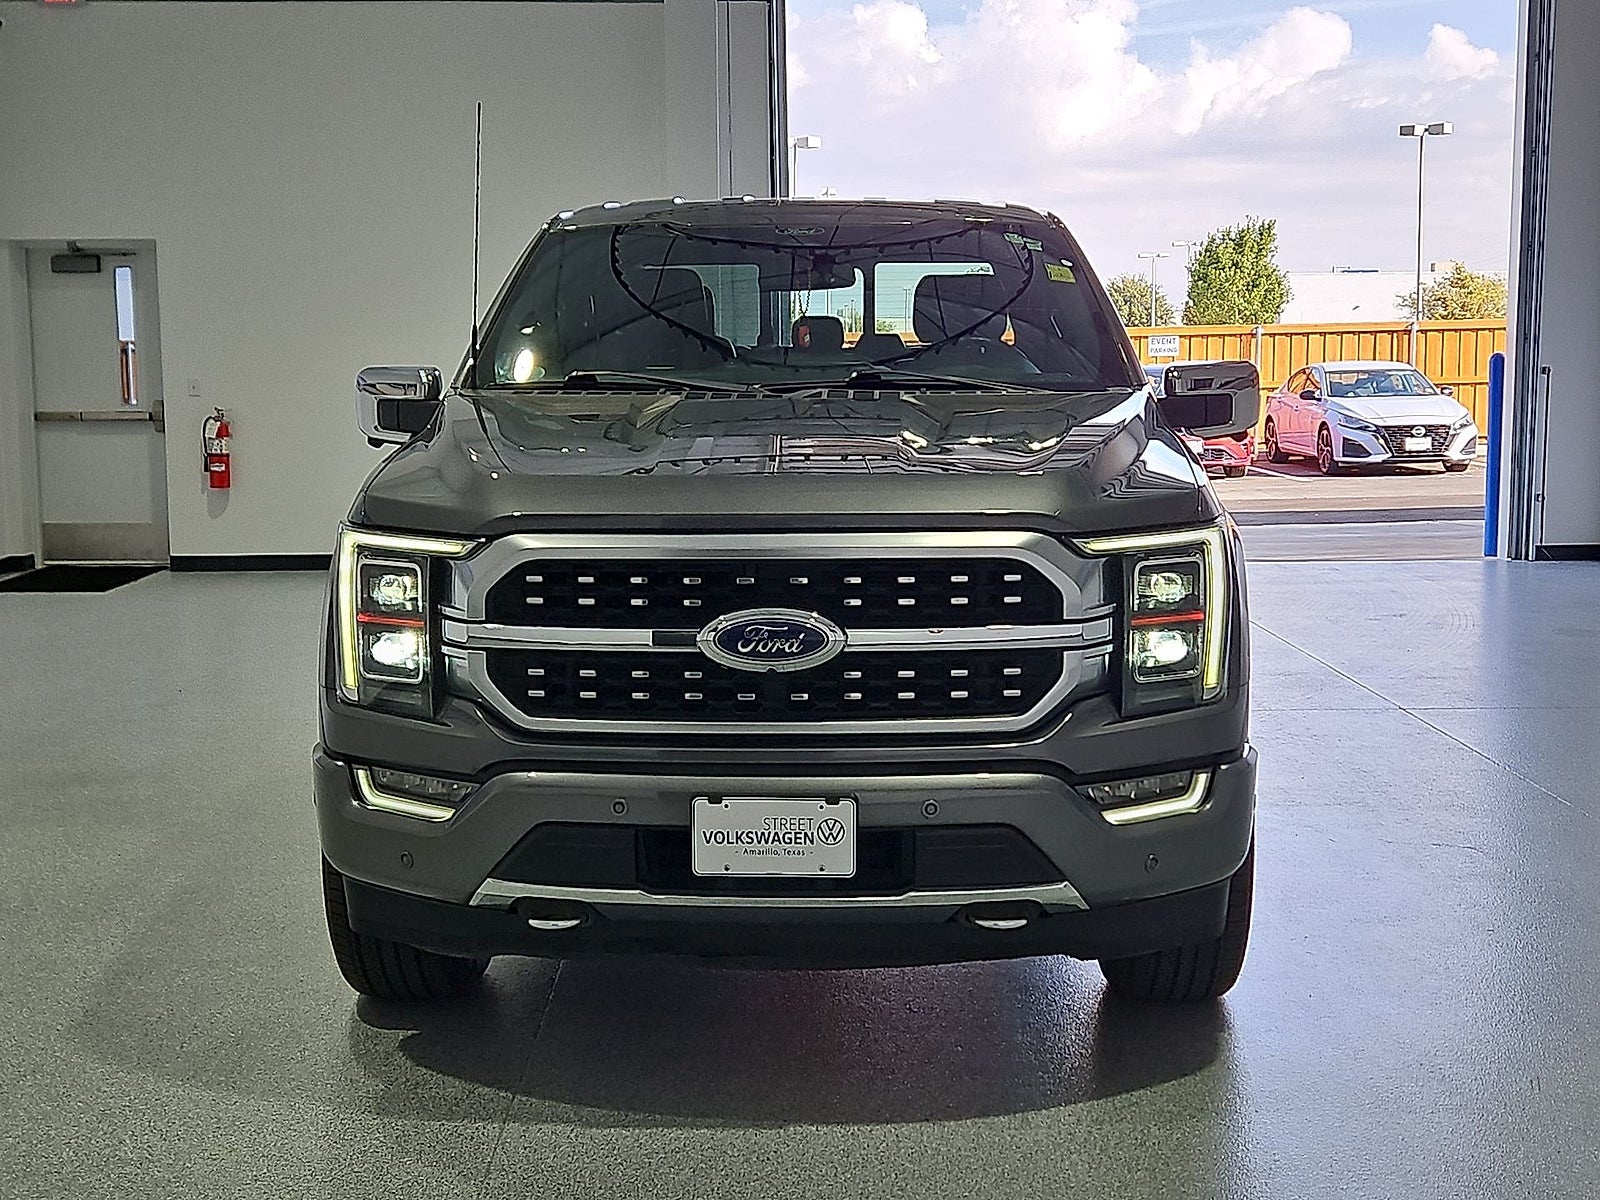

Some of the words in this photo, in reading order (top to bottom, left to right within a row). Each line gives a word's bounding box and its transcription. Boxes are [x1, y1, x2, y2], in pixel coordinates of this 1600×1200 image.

[1151, 337, 1176, 345] EVENT
[737, 625, 805, 653] Ford
[763, 817, 814, 831] STREET
[702, 830, 815, 846] VOLKSWAGEN
[742, 847, 781, 857] Amarillo,
[783, 848, 806, 857] Texas
